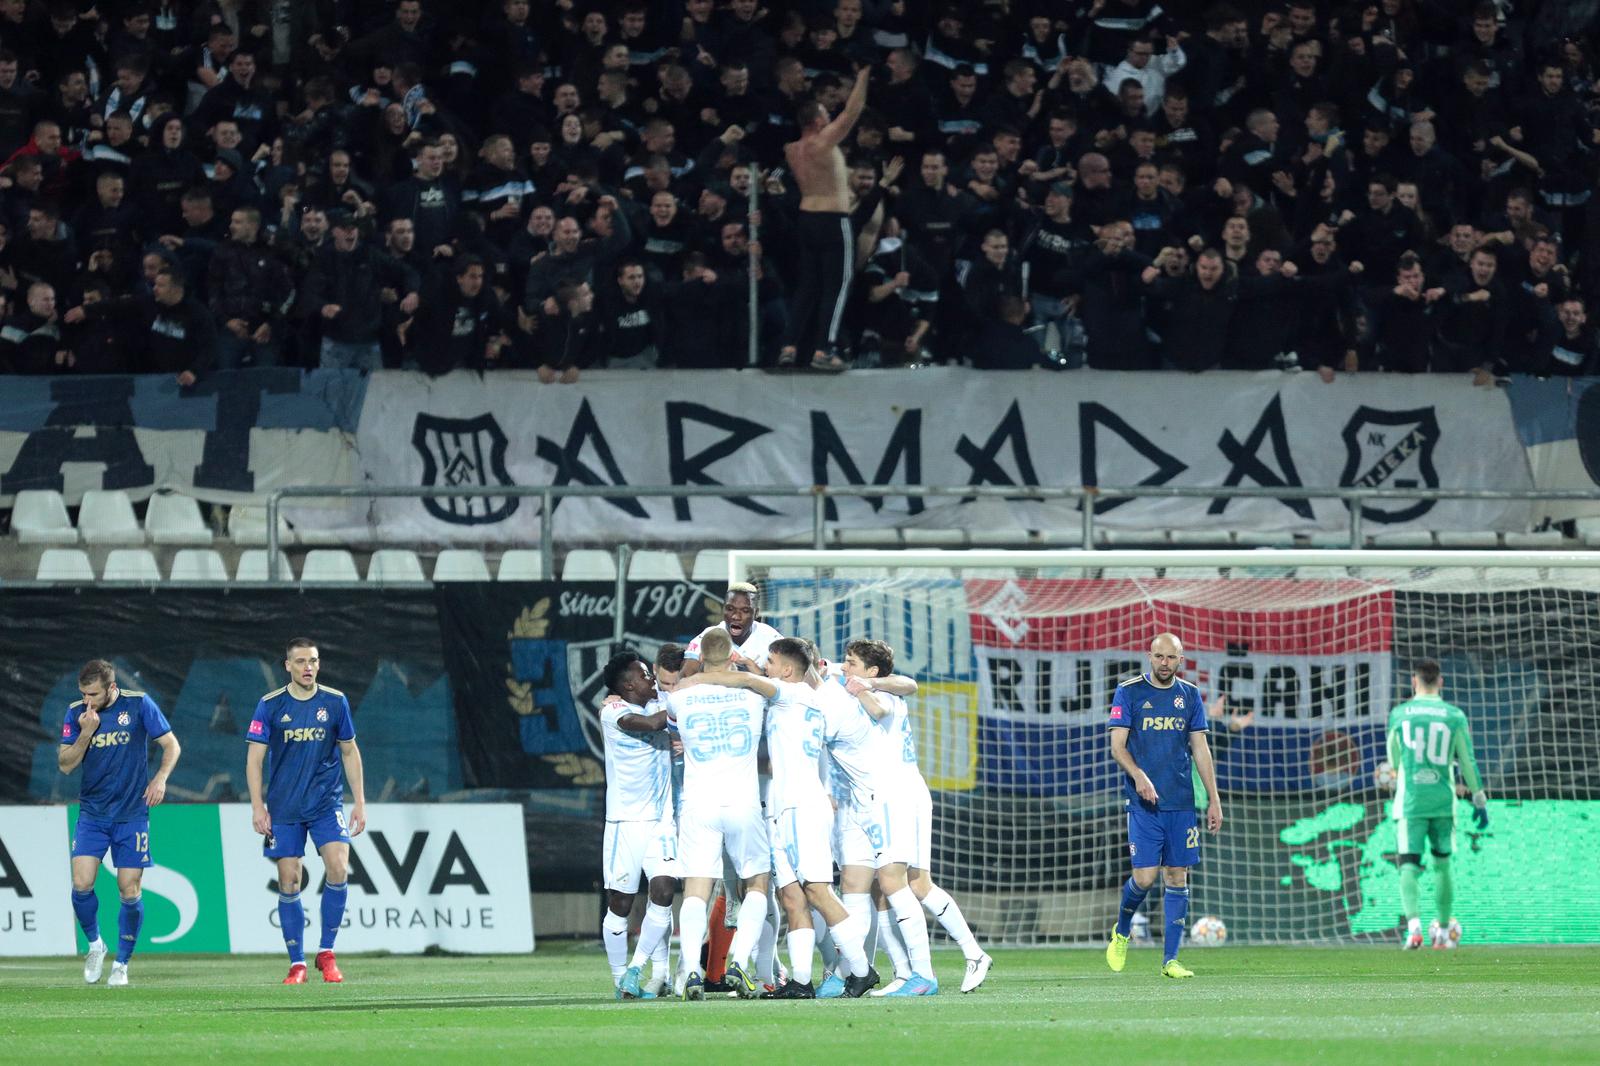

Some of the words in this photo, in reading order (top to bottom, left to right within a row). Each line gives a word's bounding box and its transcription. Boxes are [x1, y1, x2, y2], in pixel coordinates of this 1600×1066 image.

[536, 391, 1314, 522] ARMADA
[632, 584, 706, 617] 1987
[685, 708, 753, 762] 36
[1401, 720, 1451, 765] 40
[135, 832, 148, 852] 13
